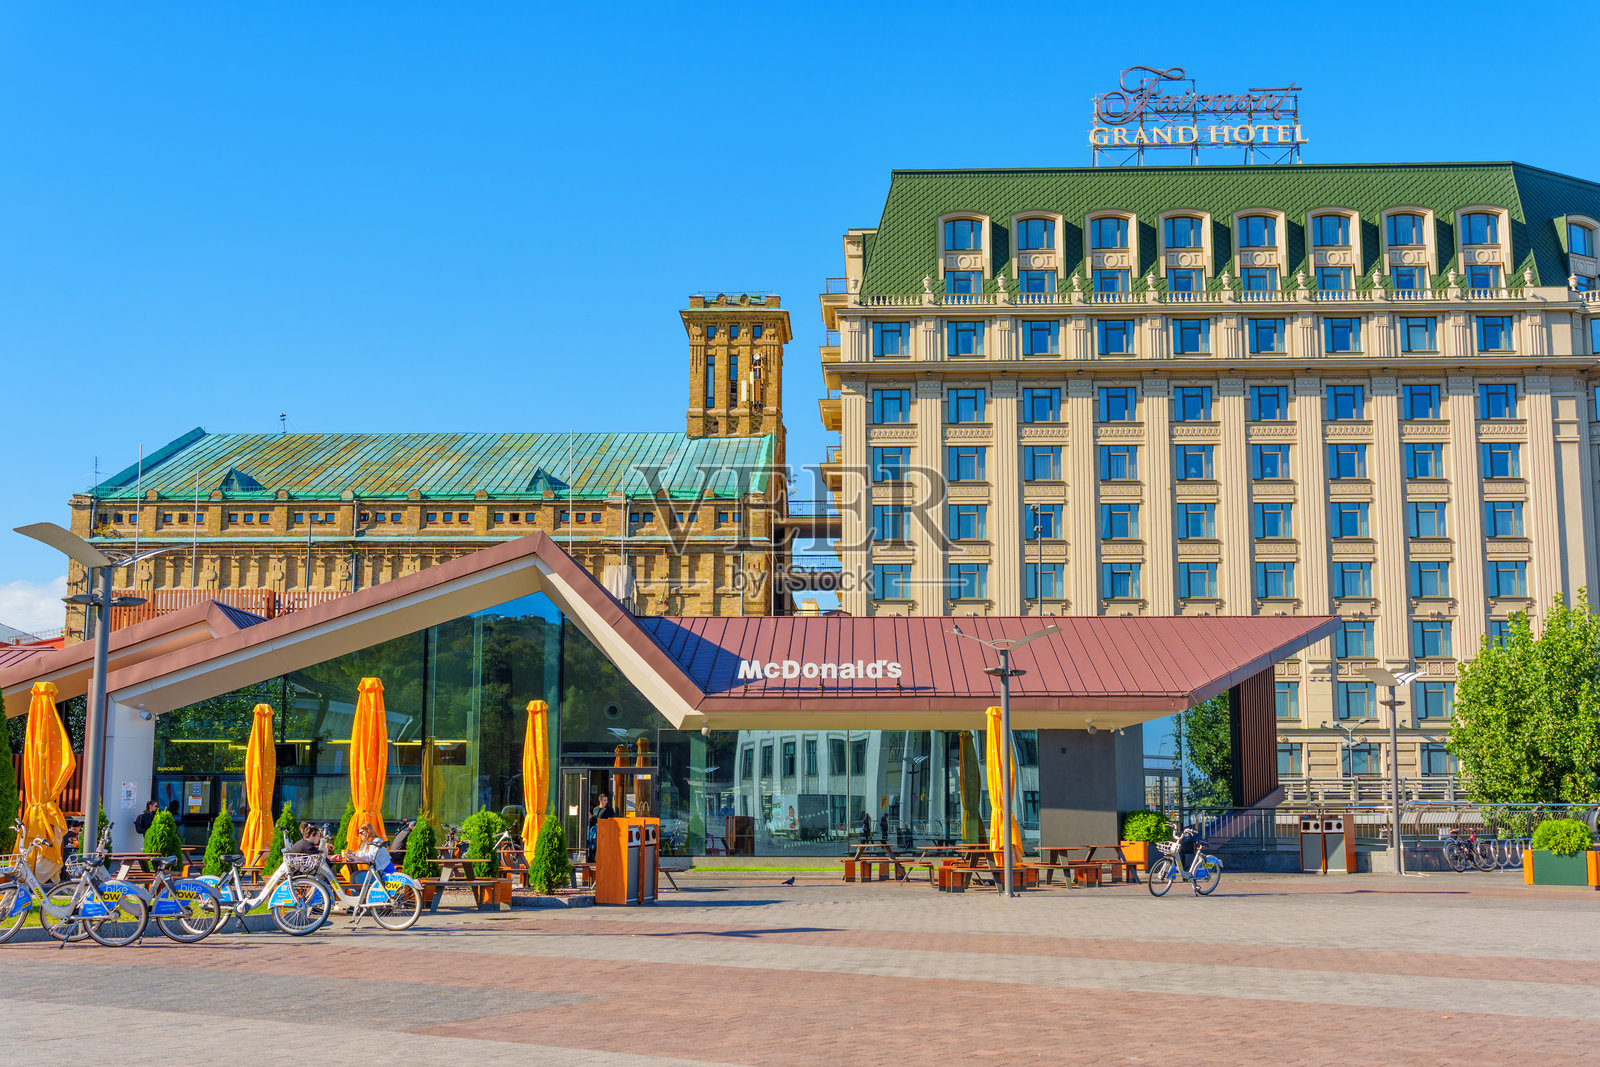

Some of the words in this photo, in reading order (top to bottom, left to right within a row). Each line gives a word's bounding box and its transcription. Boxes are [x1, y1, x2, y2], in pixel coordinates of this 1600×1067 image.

[1097, 65, 1302, 125] Fairmont
[1088, 126, 1199, 145] GRAND
[1208, 124, 1309, 144] HOTEL
[737, 660, 902, 679] McDonald's
[388, 874, 407, 884] bike
[106, 884, 129, 893] bike
[180, 883, 202, 892] bike
